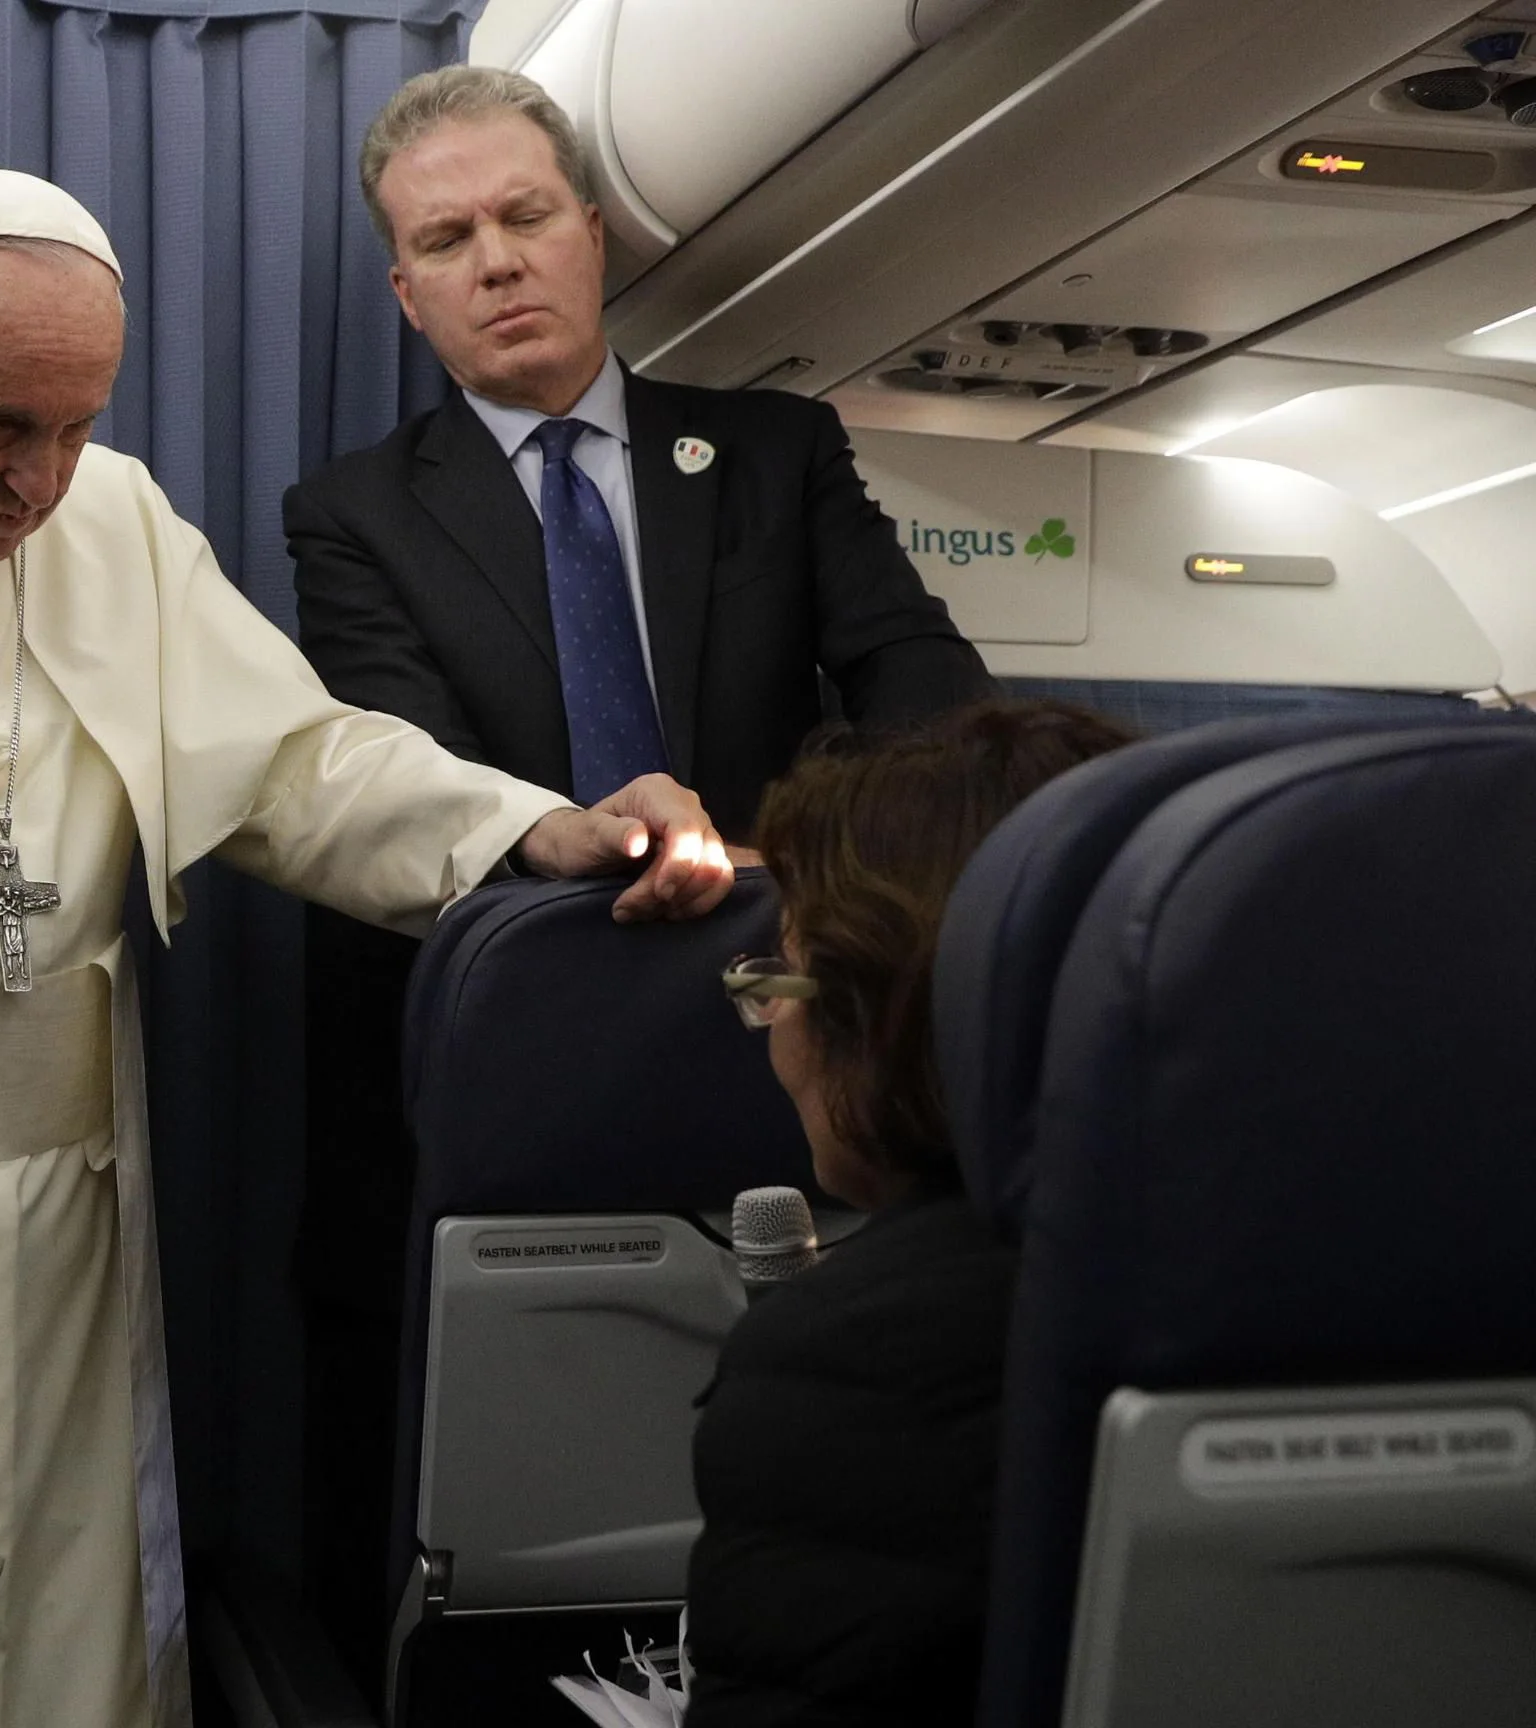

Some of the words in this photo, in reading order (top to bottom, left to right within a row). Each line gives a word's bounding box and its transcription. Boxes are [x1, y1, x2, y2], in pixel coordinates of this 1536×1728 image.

[957, 354, 971, 367] D
[979, 356, 993, 369] E
[1000, 357, 1014, 370] F
[904, 518, 1016, 566] ingus
[478, 1247, 522, 1259] FASTEN
[524, 1243, 578, 1257] SEATBELT
[580, 1242, 615, 1255] WHILE
[618, 1240, 661, 1252] SEATED
